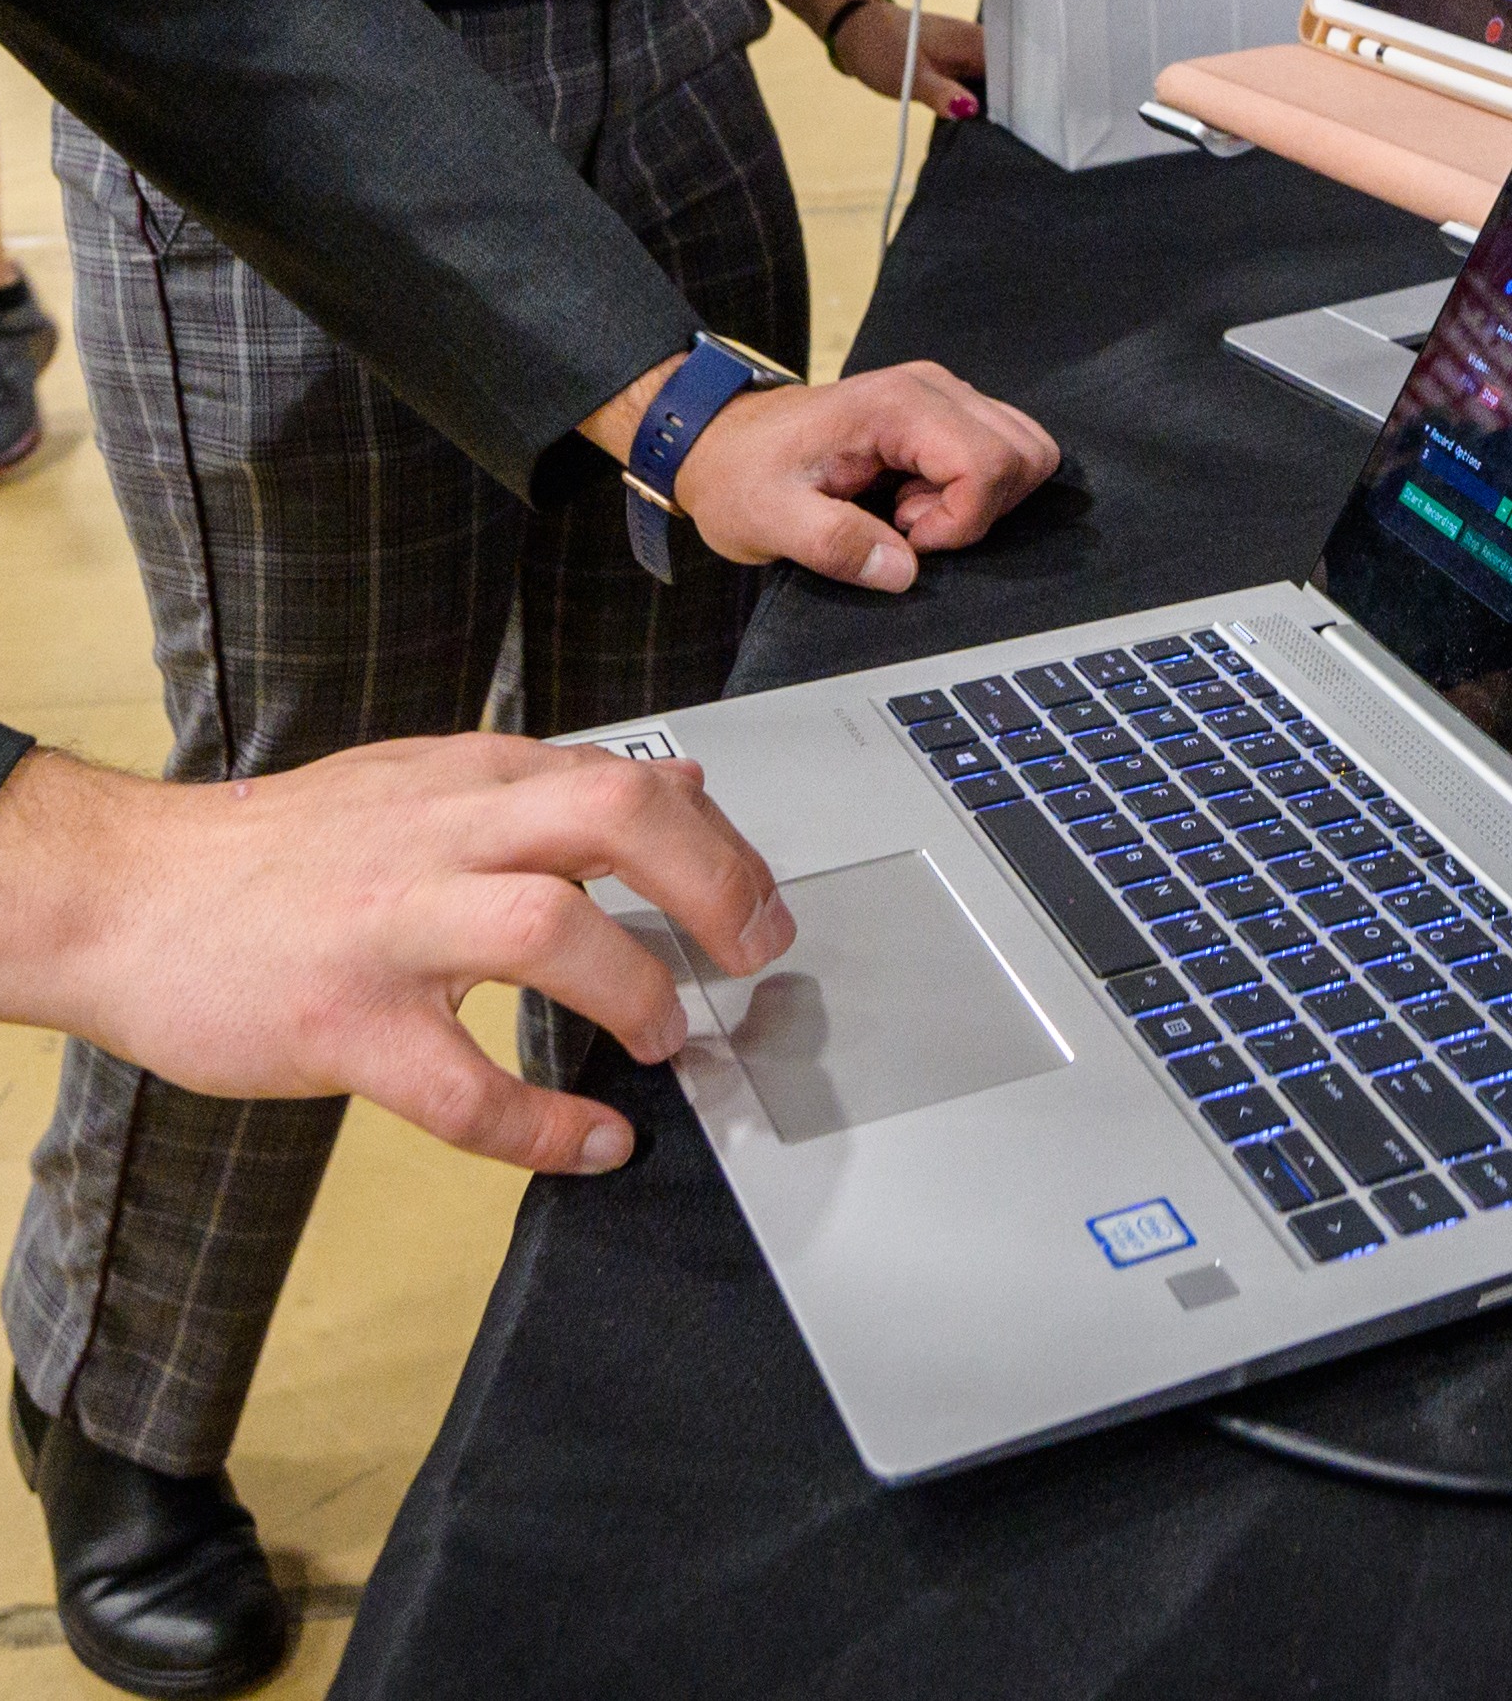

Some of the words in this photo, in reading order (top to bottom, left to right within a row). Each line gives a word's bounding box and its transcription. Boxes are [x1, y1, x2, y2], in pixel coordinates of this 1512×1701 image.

[1482, 387, 1499, 407] Stop
[1422, 448, 1430, 460] 5
[1429, 426, 1455, 452] Record
[1454, 444, 1483, 471] Options
[1403, 486, 1423, 509] Start
[1423, 501, 1459, 537] Recording
[1461, 530, 1480, 551] Stop
[1134, 686, 1148, 696] Q
[1077, 707, 1092, 717] A
[1159, 711, 1176, 724] W
[1025, 734, 1041, 742] Z
[1101, 732, 1117, 742] S
[1183, 738, 1200, 748] E
[1049, 761, 1066, 772] X
[1126, 759, 1142, 769] D
[1210, 766, 1226, 777] R
[1075, 790, 1090, 801] C
[1152, 788, 1168, 799] F
[1239, 794, 1254, 804] T
[1101, 820, 1117, 831] V
[1181, 820, 1196, 831] G
[1270, 826, 1285, 836] Y
[1126, 851, 1143, 862] B
[1208, 850, 1226, 862] H
[1298, 858, 1315, 869] U
[1154, 884, 1173, 897] N
[1238, 885, 1254, 894] J
[1184, 919, 1203, 932] M
[1269, 919, 1287, 931] K
[1364, 927, 1381, 939] O
[1301, 953, 1316, 965] L
[1397, 961, 1415, 973] P
